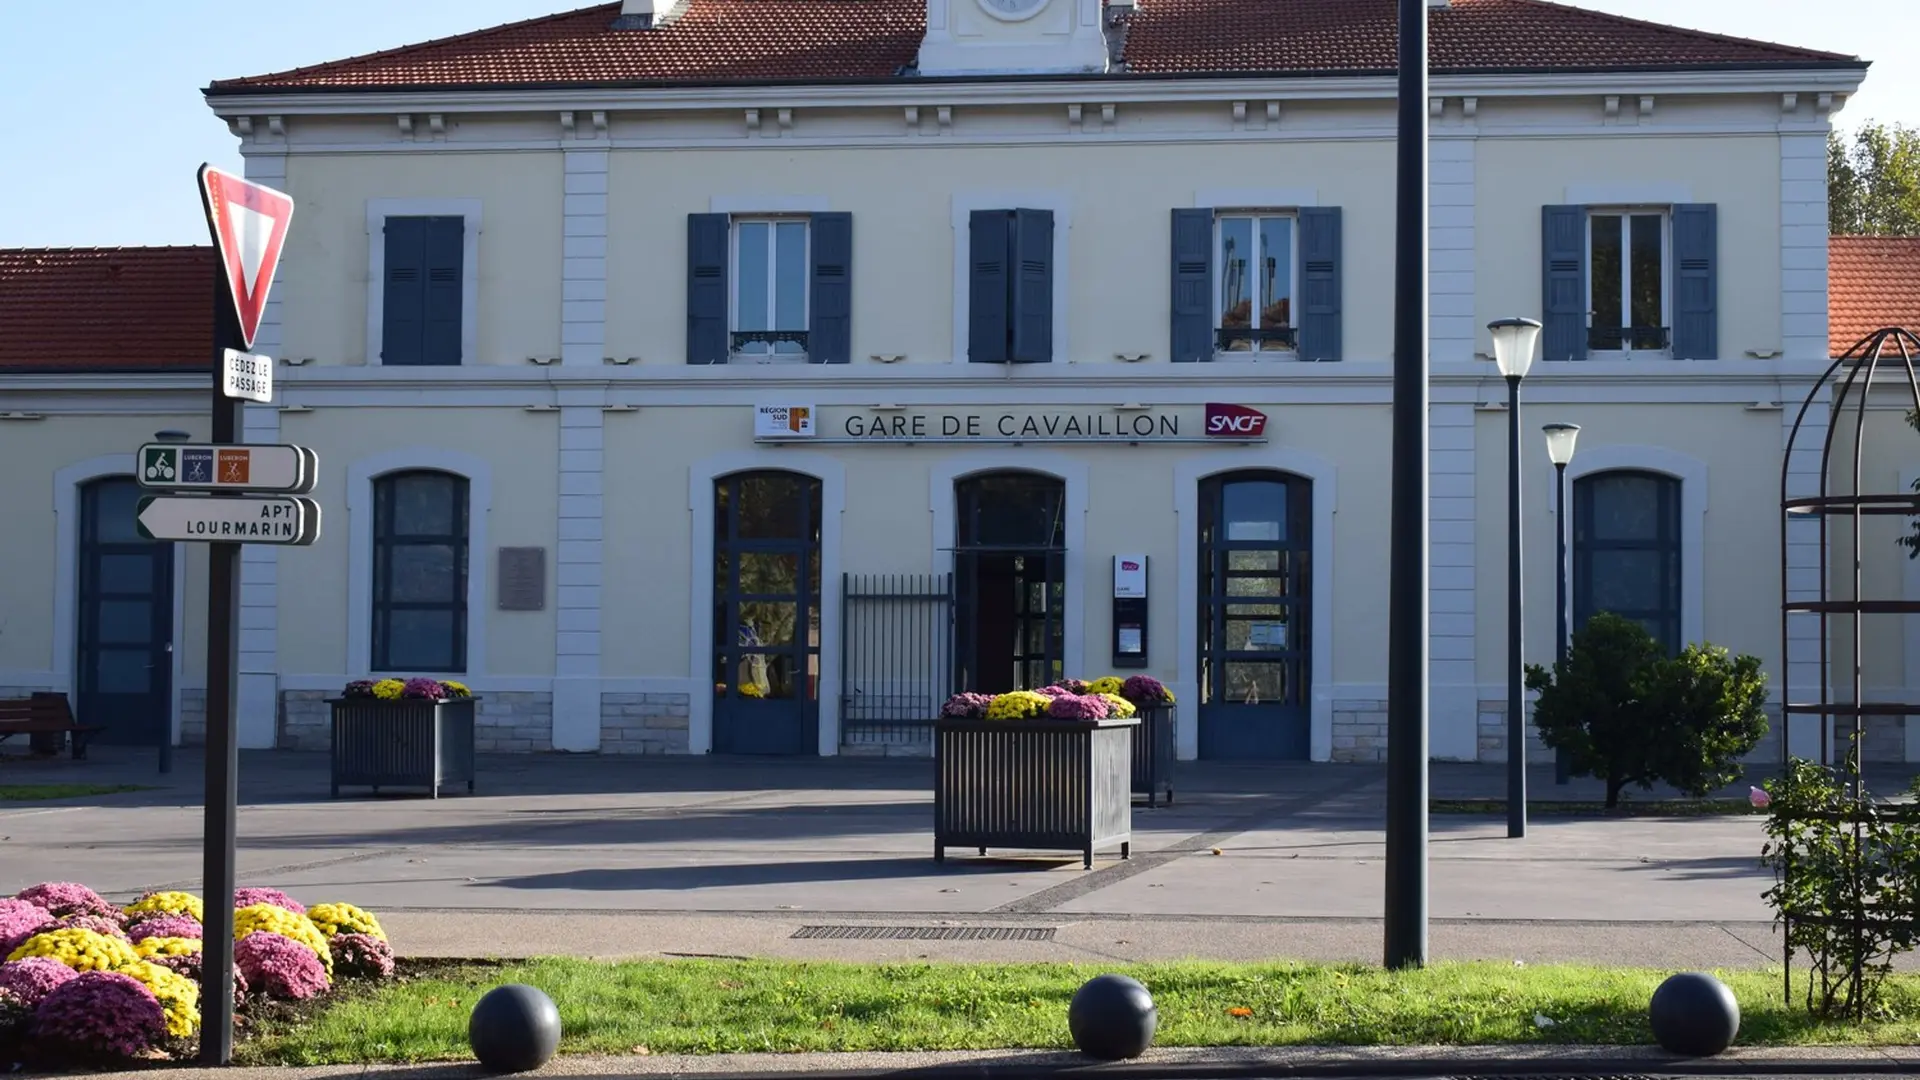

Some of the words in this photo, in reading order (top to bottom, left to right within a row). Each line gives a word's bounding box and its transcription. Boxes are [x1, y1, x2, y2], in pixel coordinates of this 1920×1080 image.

[229, 355, 256, 375] CÉDEZ
[258, 363, 267, 377] LE
[230, 375, 266, 394] PASSAGE
[845, 415, 926, 436] GARE
[942, 415, 981, 436] DE
[997, 415, 1178, 436] CAVAILLON
[1208, 415, 1264, 431] SNCF
[261, 505, 292, 518] APT
[187, 521, 292, 536] LOURMARIN
